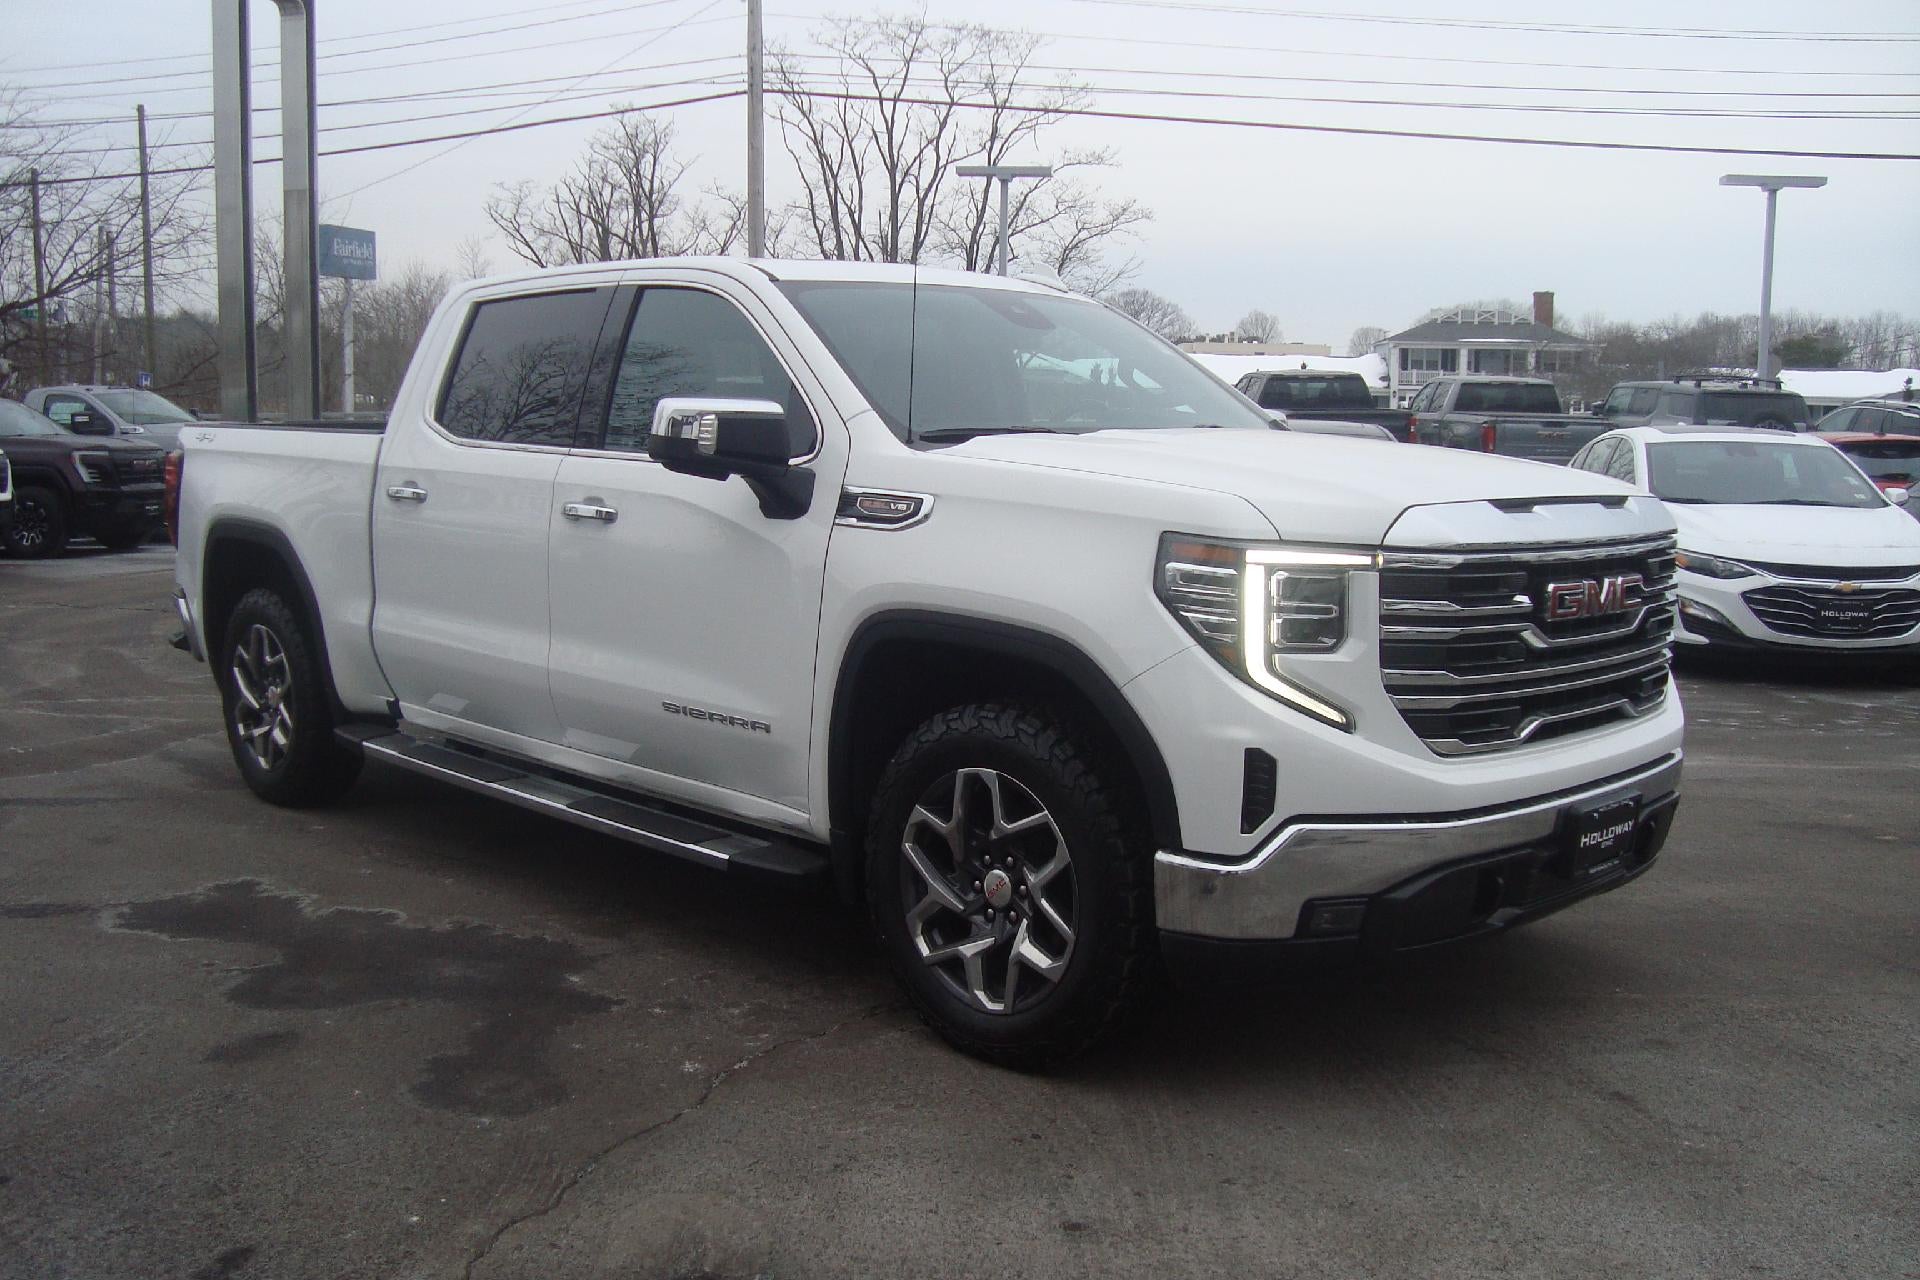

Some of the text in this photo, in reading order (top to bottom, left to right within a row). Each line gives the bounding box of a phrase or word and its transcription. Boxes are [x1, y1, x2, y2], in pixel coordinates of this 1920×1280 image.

[334, 238, 374, 260] Fairfield
[890, 502, 907, 511] V8
[1547, 575, 1644, 622] GMC
[661, 700, 771, 734] SIERRA
[1580, 819, 1635, 849] HOLLOWAY
